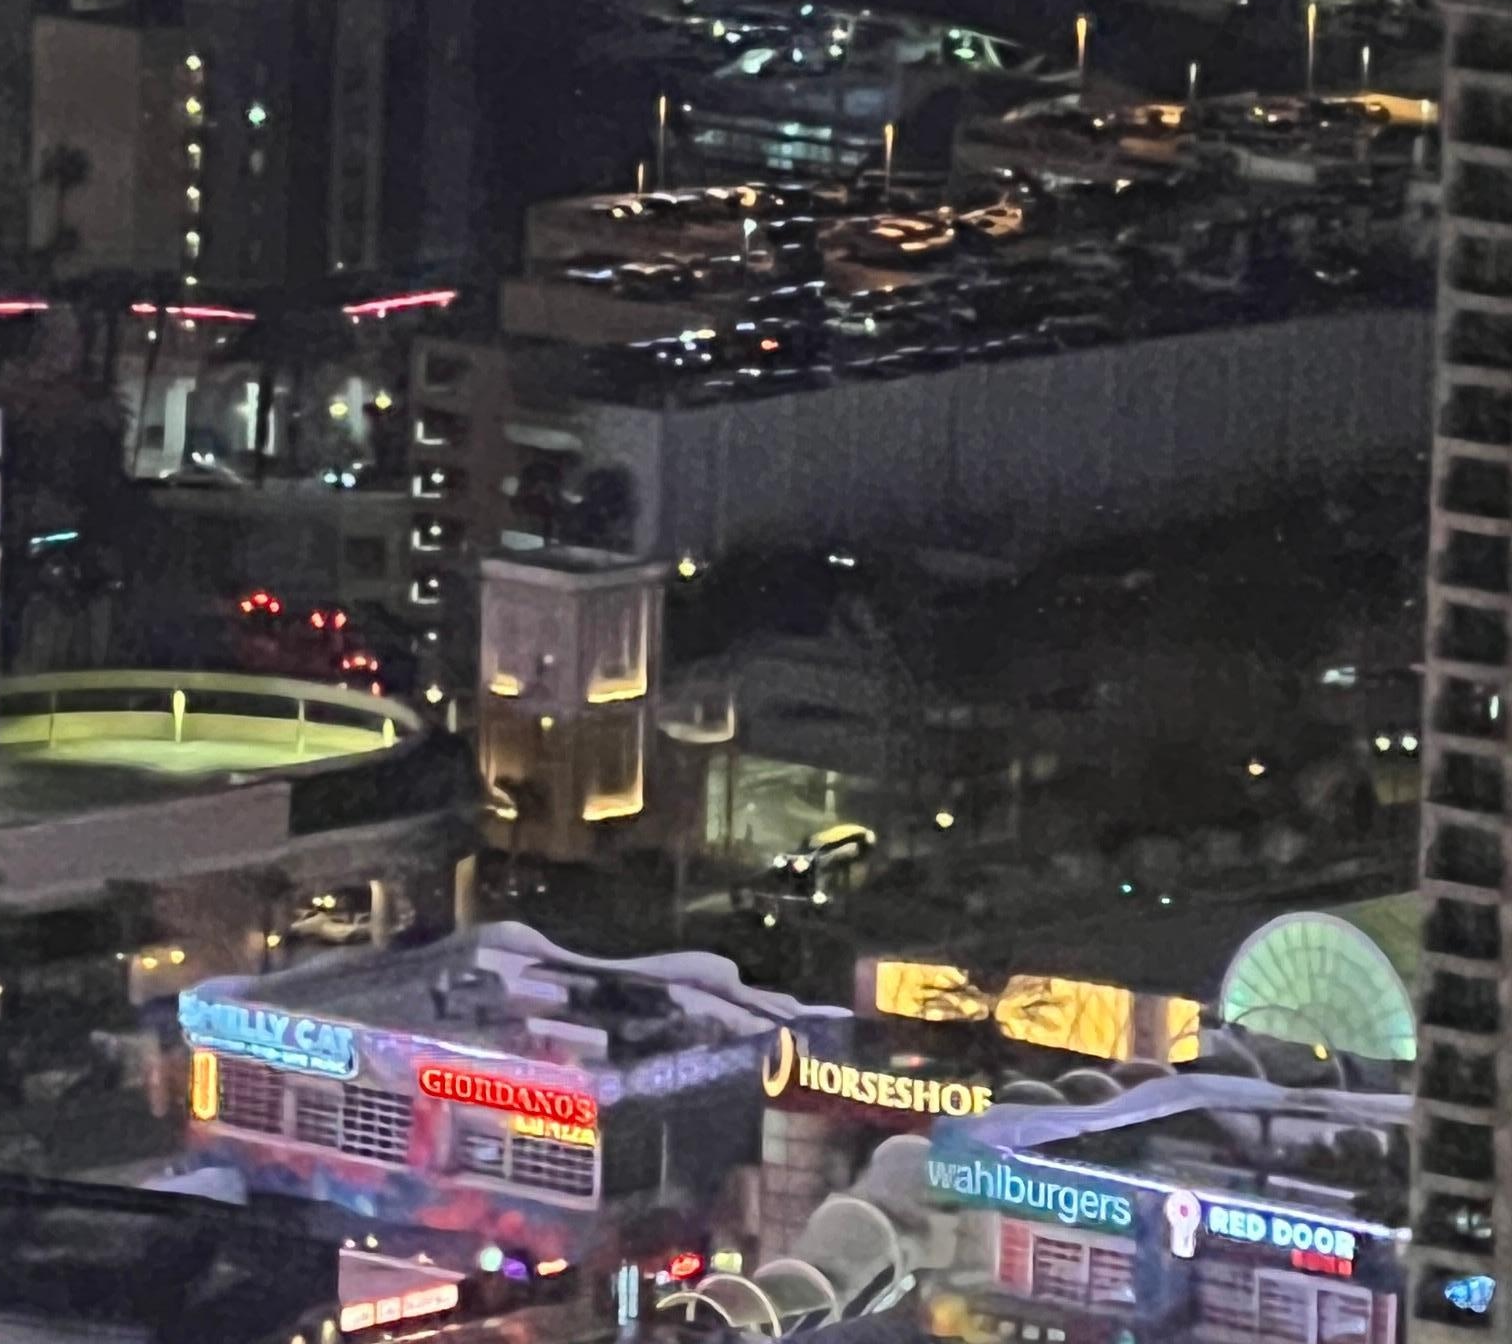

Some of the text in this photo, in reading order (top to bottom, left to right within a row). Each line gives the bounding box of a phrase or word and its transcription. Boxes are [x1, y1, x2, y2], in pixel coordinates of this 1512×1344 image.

[799, 1056, 994, 1117] HORSESHOE
[928, 1160, 1132, 1226] wahlburgers
[1208, 1205, 1357, 1261] RED DOOR
